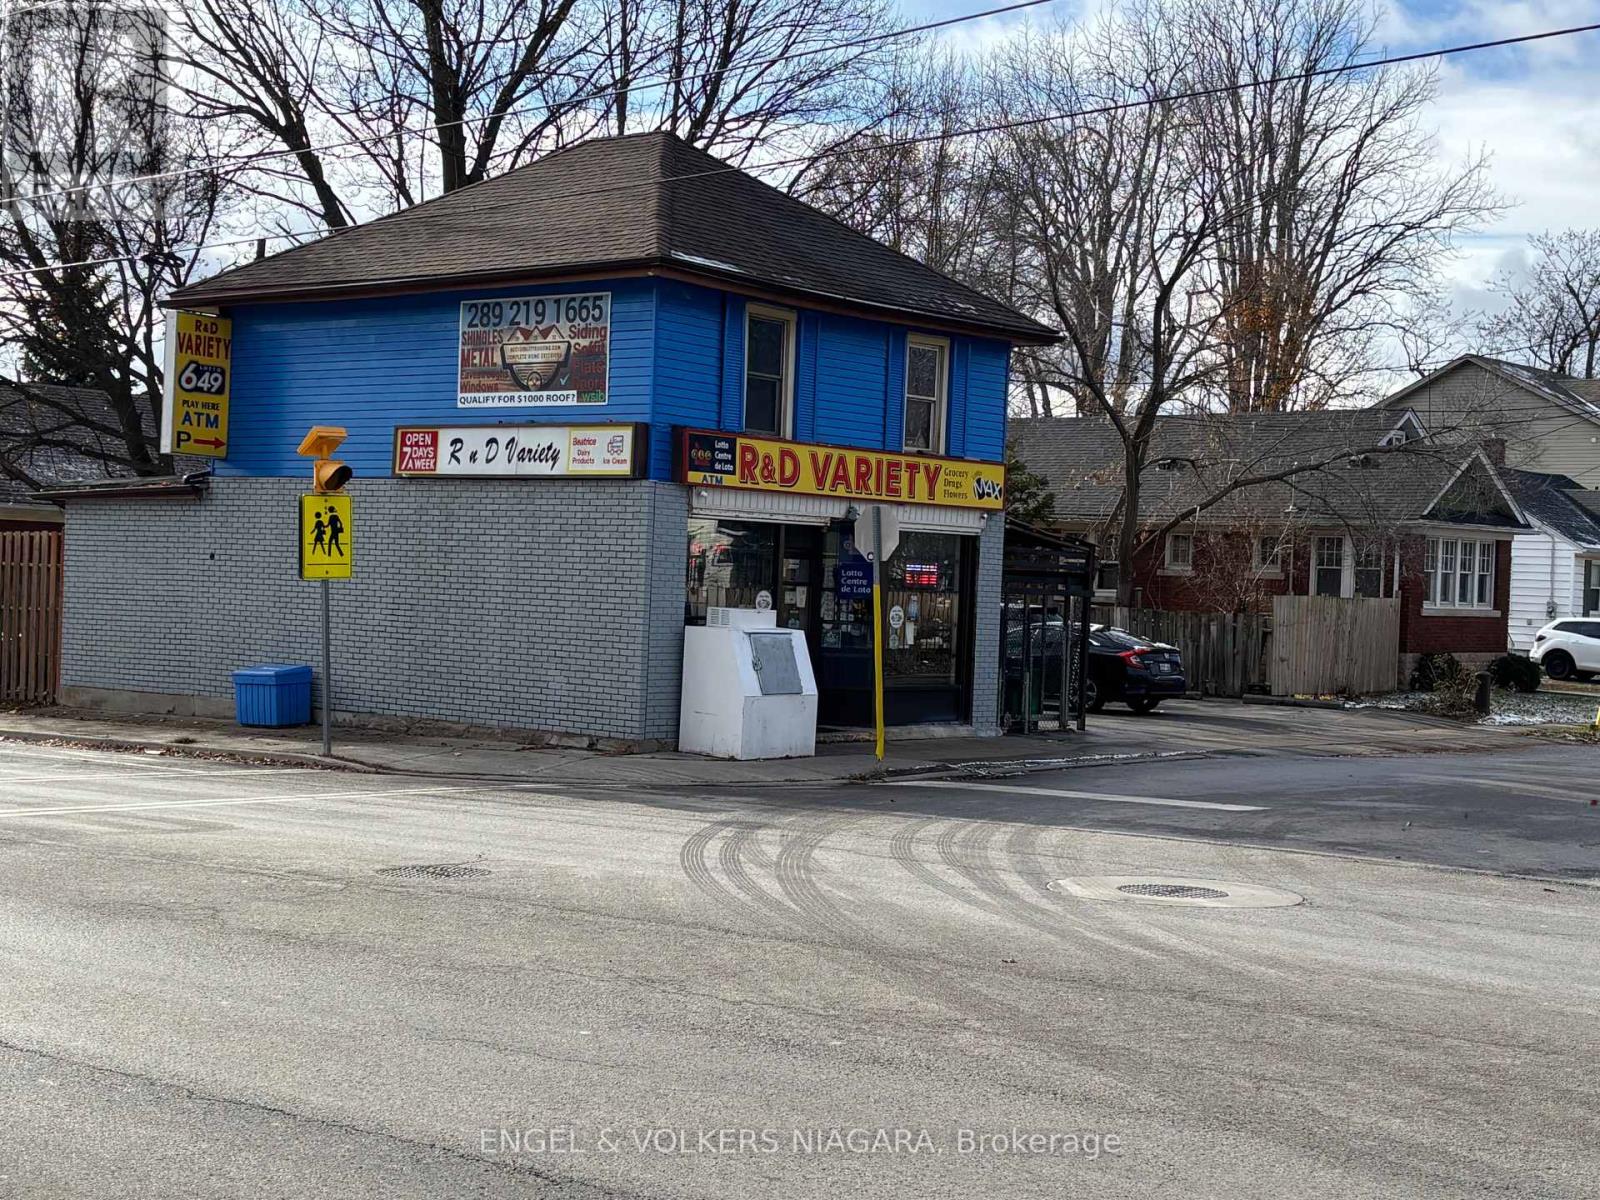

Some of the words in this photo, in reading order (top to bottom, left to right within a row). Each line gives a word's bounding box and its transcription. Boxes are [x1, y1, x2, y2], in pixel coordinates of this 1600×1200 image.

[467, 301, 503, 328] 289
[509, 299, 546, 326] 219
[554, 295, 604, 324] 1665
[195, 319, 219, 334] R&D
[568, 324, 607, 341] Siding
[177, 332, 231, 360] VARIETY
[461, 348, 497, 368] METAL
[182, 399, 200, 410] PLAY
[201, 400, 221, 411] HERE
[459, 395, 496, 405] QUALIFY
[497, 395, 515, 404] FOR
[517, 394, 543, 403] $1000
[546, 393, 575, 402] ROOF?
[181, 411, 219, 429] ATM
[176, 430, 192, 449] P
[405, 432, 432, 446] OPEN
[714, 439, 729, 449] Lotto
[401, 448, 411, 470] 7
[411, 446, 434, 458] DAYS
[448, 437, 464, 465] R
[468, 449, 479, 462] n
[484, 436, 500, 465] D
[504, 435, 561, 471] Variety
[714, 450, 732, 461] Centre
[408, 459, 415, 470] A
[415, 458, 436, 470] WEEK
[739, 443, 801, 488] R&D
[808, 449, 943, 501] VARIETY
[943, 466, 969, 478] Grocery
[701, 474, 724, 486] ATM
[973, 477, 1002, 500] MAX
[841, 569, 863, 577] Lotto
[840, 577, 868, 586] Centre
[841, 585, 851, 593] de
[853, 586, 871, 594] Loto
